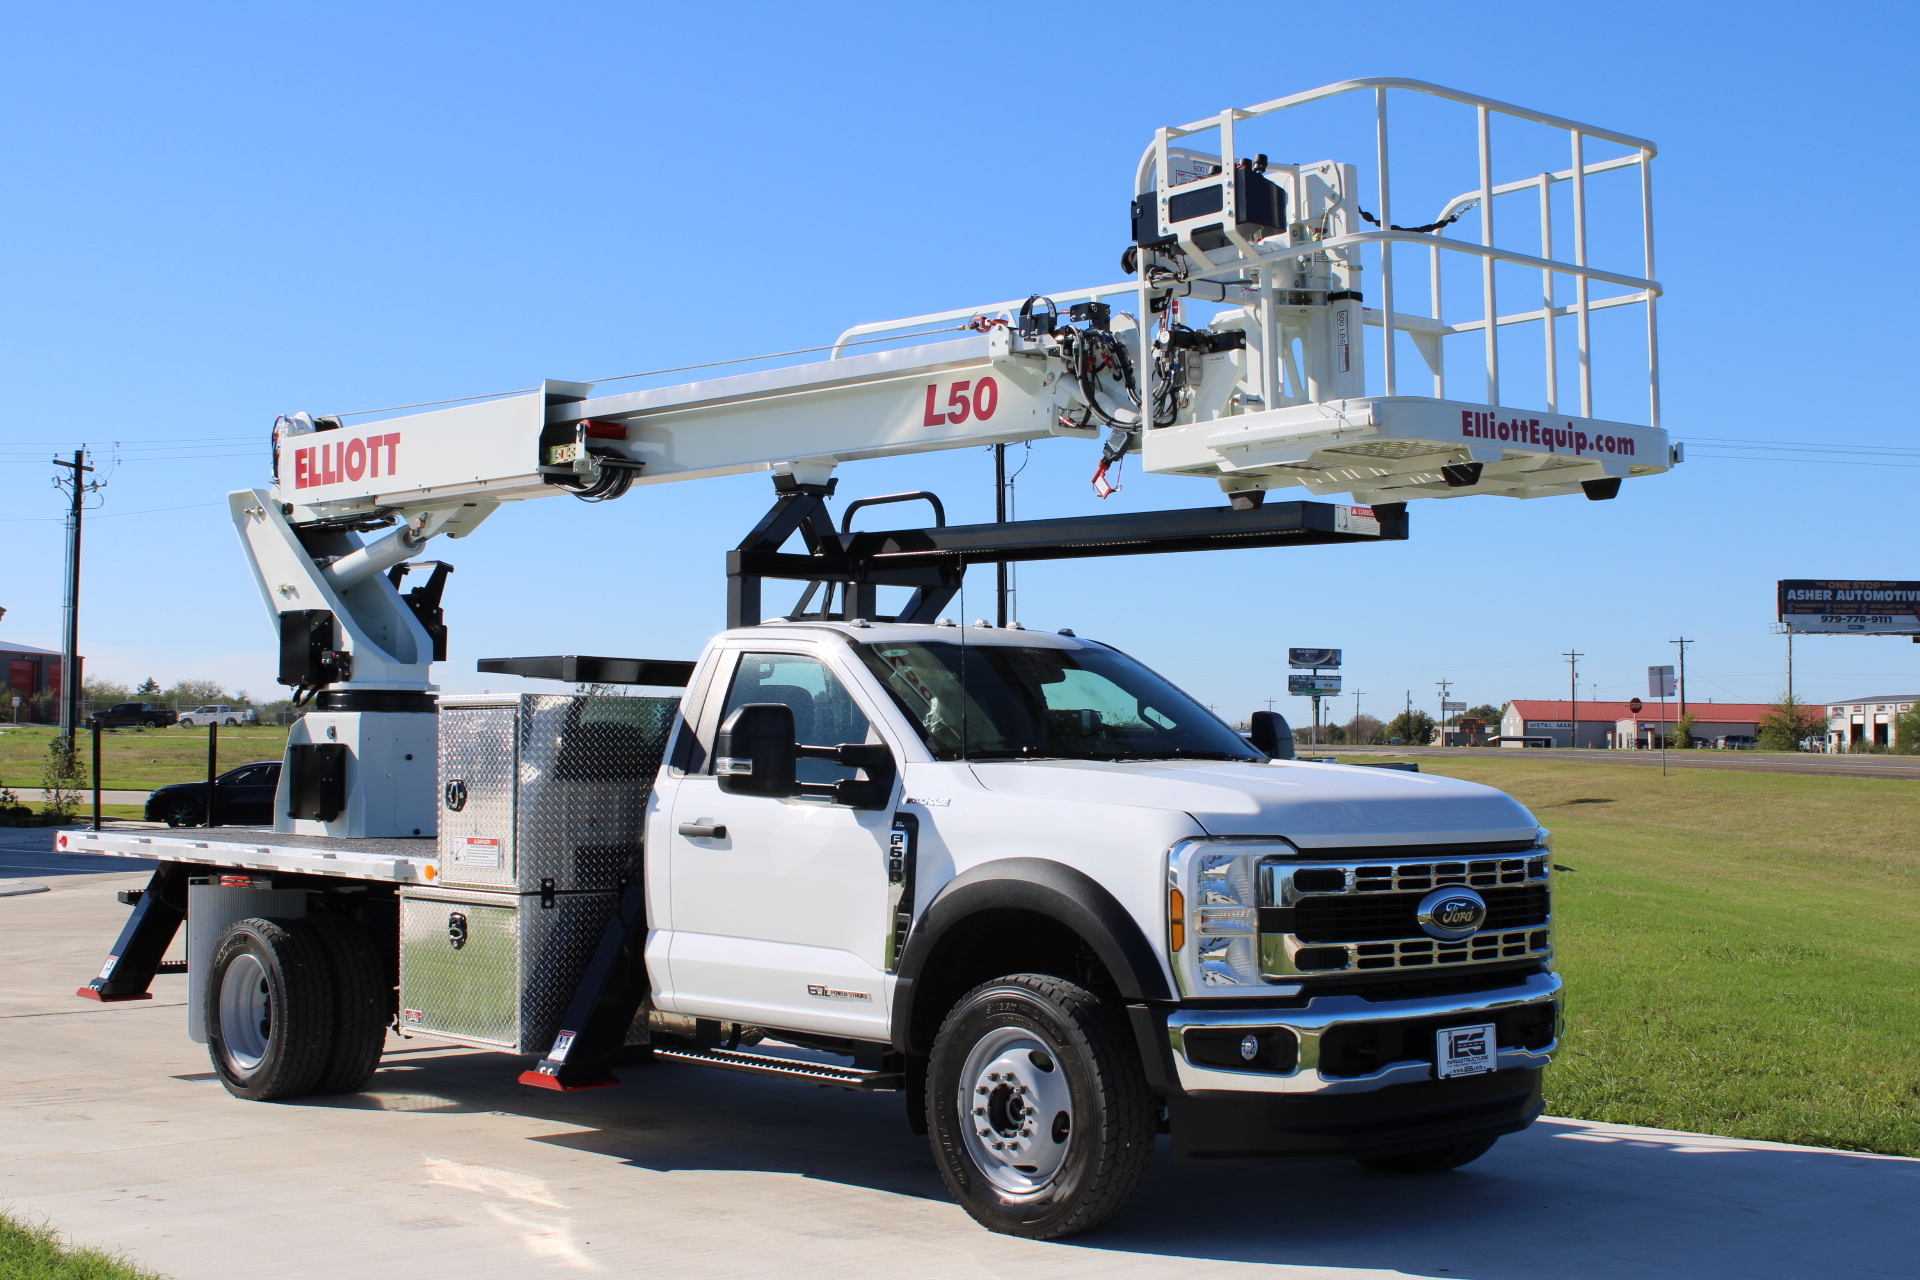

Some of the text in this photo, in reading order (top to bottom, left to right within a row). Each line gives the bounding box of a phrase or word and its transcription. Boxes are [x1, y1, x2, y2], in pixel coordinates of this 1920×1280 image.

[923, 376, 998, 427] L50
[1461, 410, 1635, 456] ElliottEquip.com
[295, 432, 401, 489] ELLIOTT
[1828, 581, 1850, 589] ONE
[1853, 581, 1881, 590] STOP
[1787, 589, 1920, 602] ASHER AUTOMOTIVE
[1821, 615, 1893, 623] 979-778-9111
[1443, 901, 1475, 924] Ford
[1446, 1055, 1489, 1065] INFRASTRUCTURE
